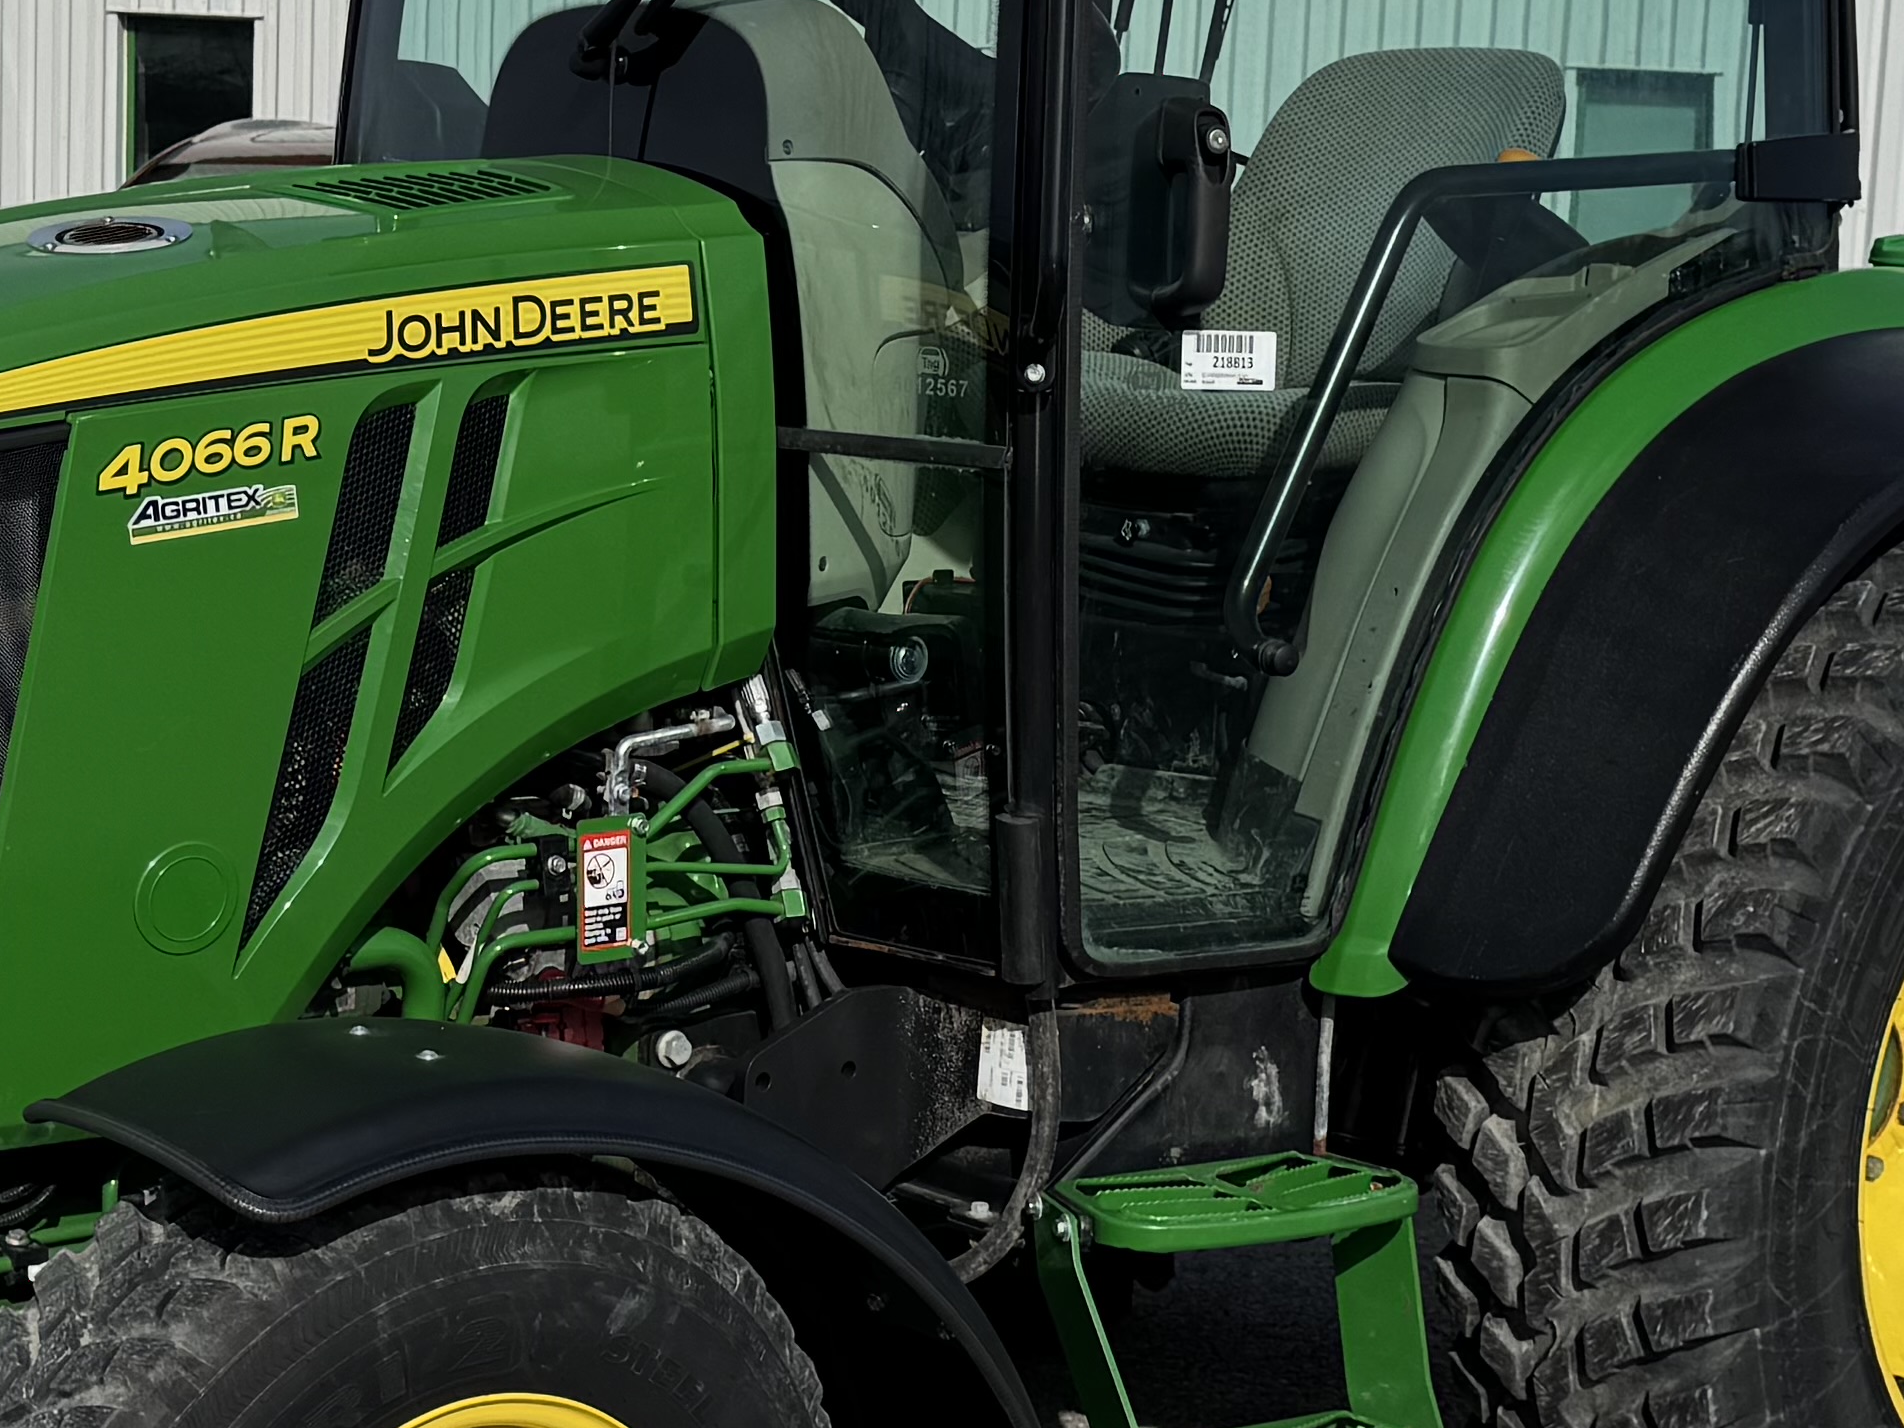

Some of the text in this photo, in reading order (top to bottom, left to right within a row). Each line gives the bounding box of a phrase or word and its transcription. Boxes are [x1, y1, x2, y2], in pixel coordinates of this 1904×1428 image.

[367, 289, 663, 358] JOHN DEERE
[97, 413, 322, 497] 4066 R
[132, 487, 262, 526] AGRITEX
[598, 1330, 721, 1428] STEEL
